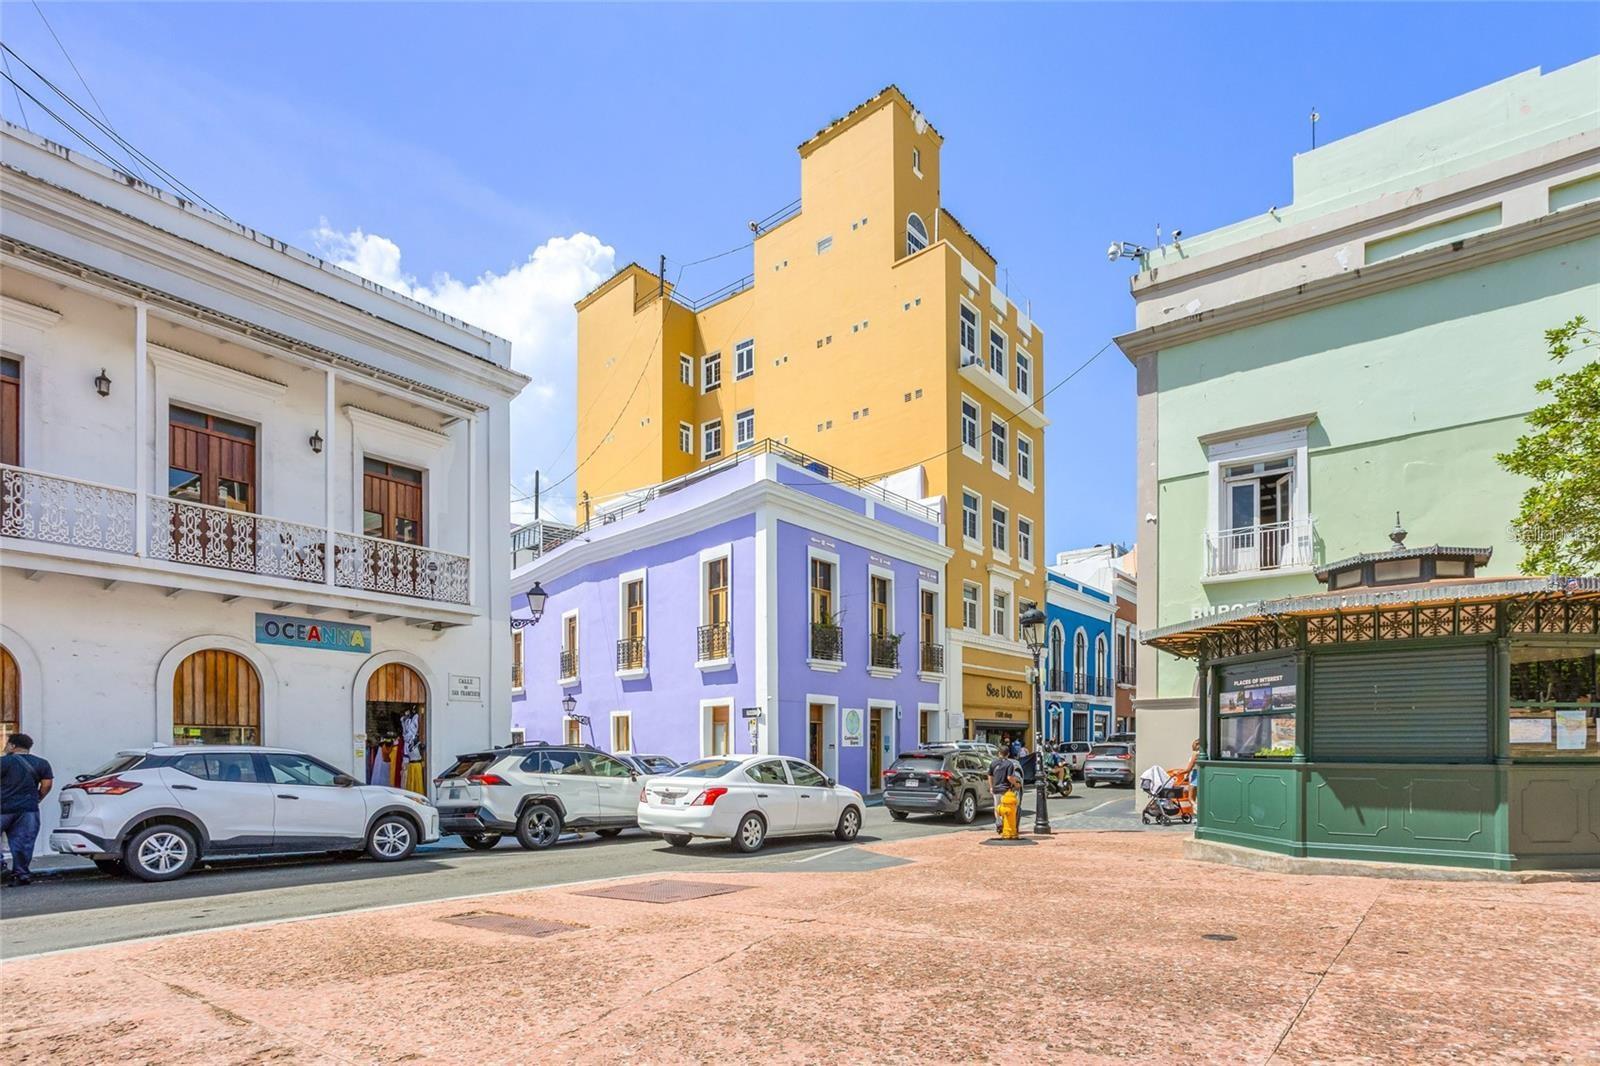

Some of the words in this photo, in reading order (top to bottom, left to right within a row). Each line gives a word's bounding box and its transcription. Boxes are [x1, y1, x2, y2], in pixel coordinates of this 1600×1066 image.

[264, 620, 365, 647] OCEANNA
[986, 683, 1000, 698] See
[1001, 686, 1006, 698] U
[1007, 686, 1022, 699] Soon
